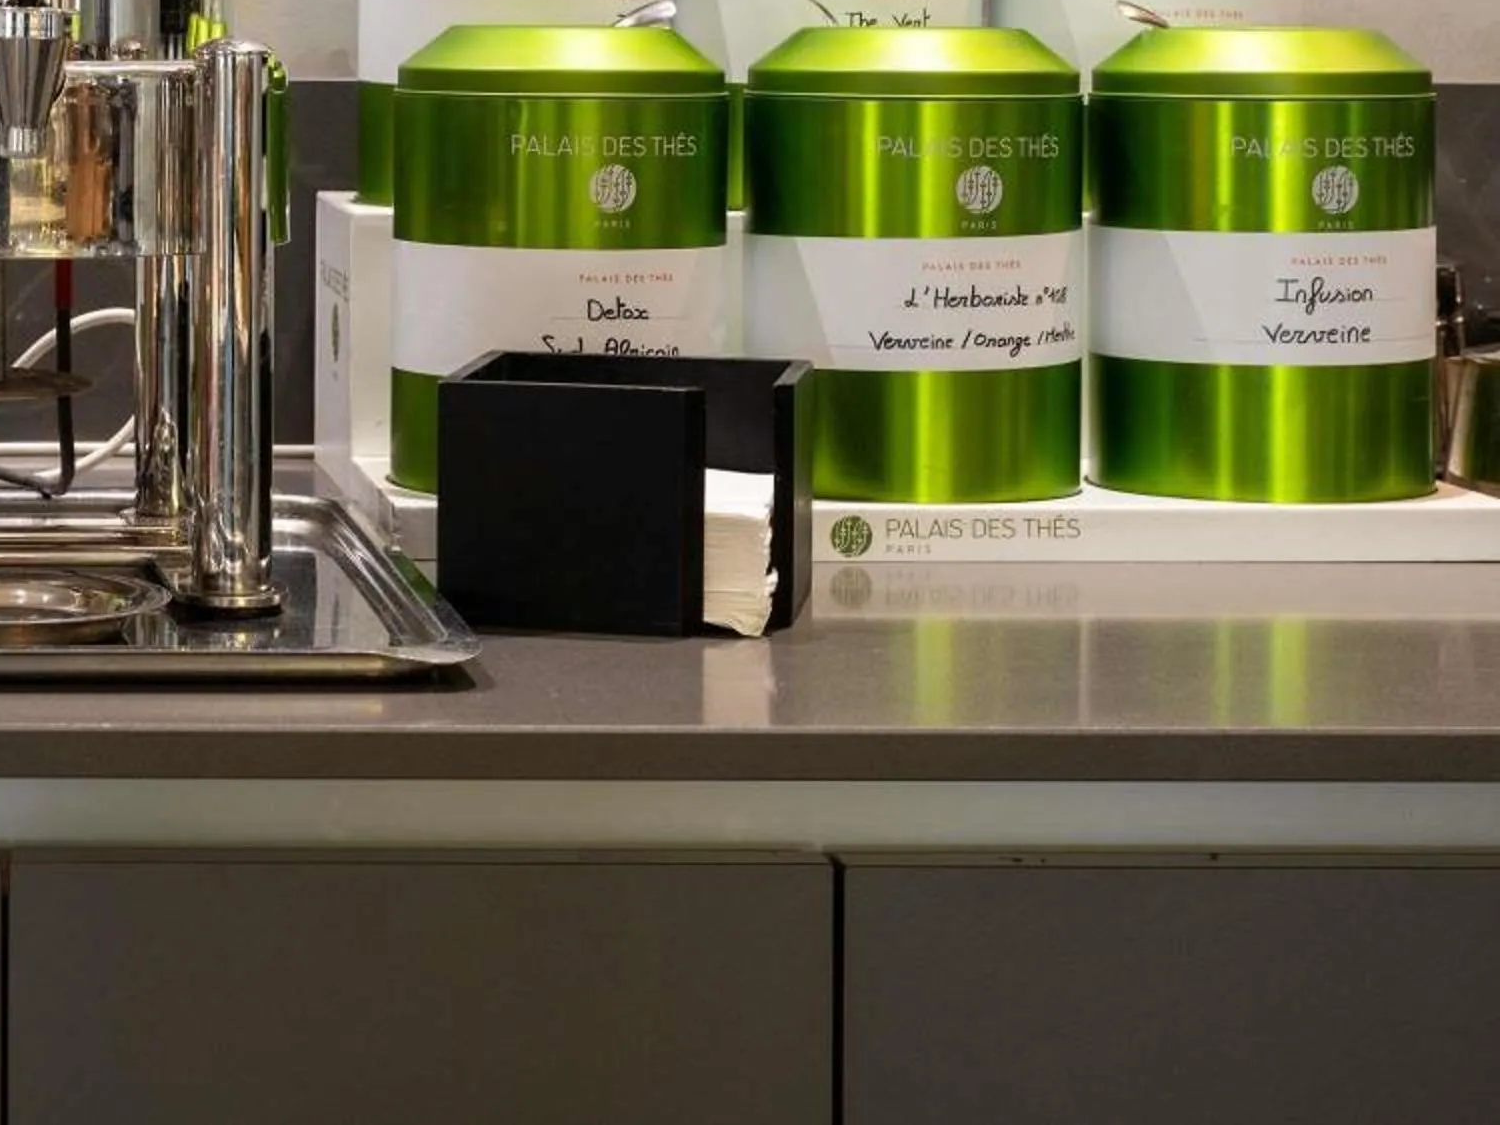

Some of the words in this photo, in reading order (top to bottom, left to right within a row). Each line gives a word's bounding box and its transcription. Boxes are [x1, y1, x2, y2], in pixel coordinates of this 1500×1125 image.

[511, 134, 595, 156] PALAIS
[603, 136, 647, 156] DES
[652, 132, 698, 157] THÉS
[877, 136, 963, 158] PALIS
[969, 137, 1013, 158] DES
[1019, 132, 1060, 159] THÉS
[1231, 136, 1318, 158] PALAS
[1325, 137, 1368, 158] DES
[1372, 131, 1416, 158] THÉS
[961, 220, 998, 230] PARIS
[1274, 276, 1373, 315] Infusion
[587, 296, 650, 321] Detox
[868, 330, 954, 350] Verveine
[1261, 323, 1372, 344] Verveine
[886, 518, 963, 540] PALAIS
[972, 518, 1016, 539] DES
[1023, 514, 1081, 539] THÉS
[886, 545, 932, 554] PARIS
